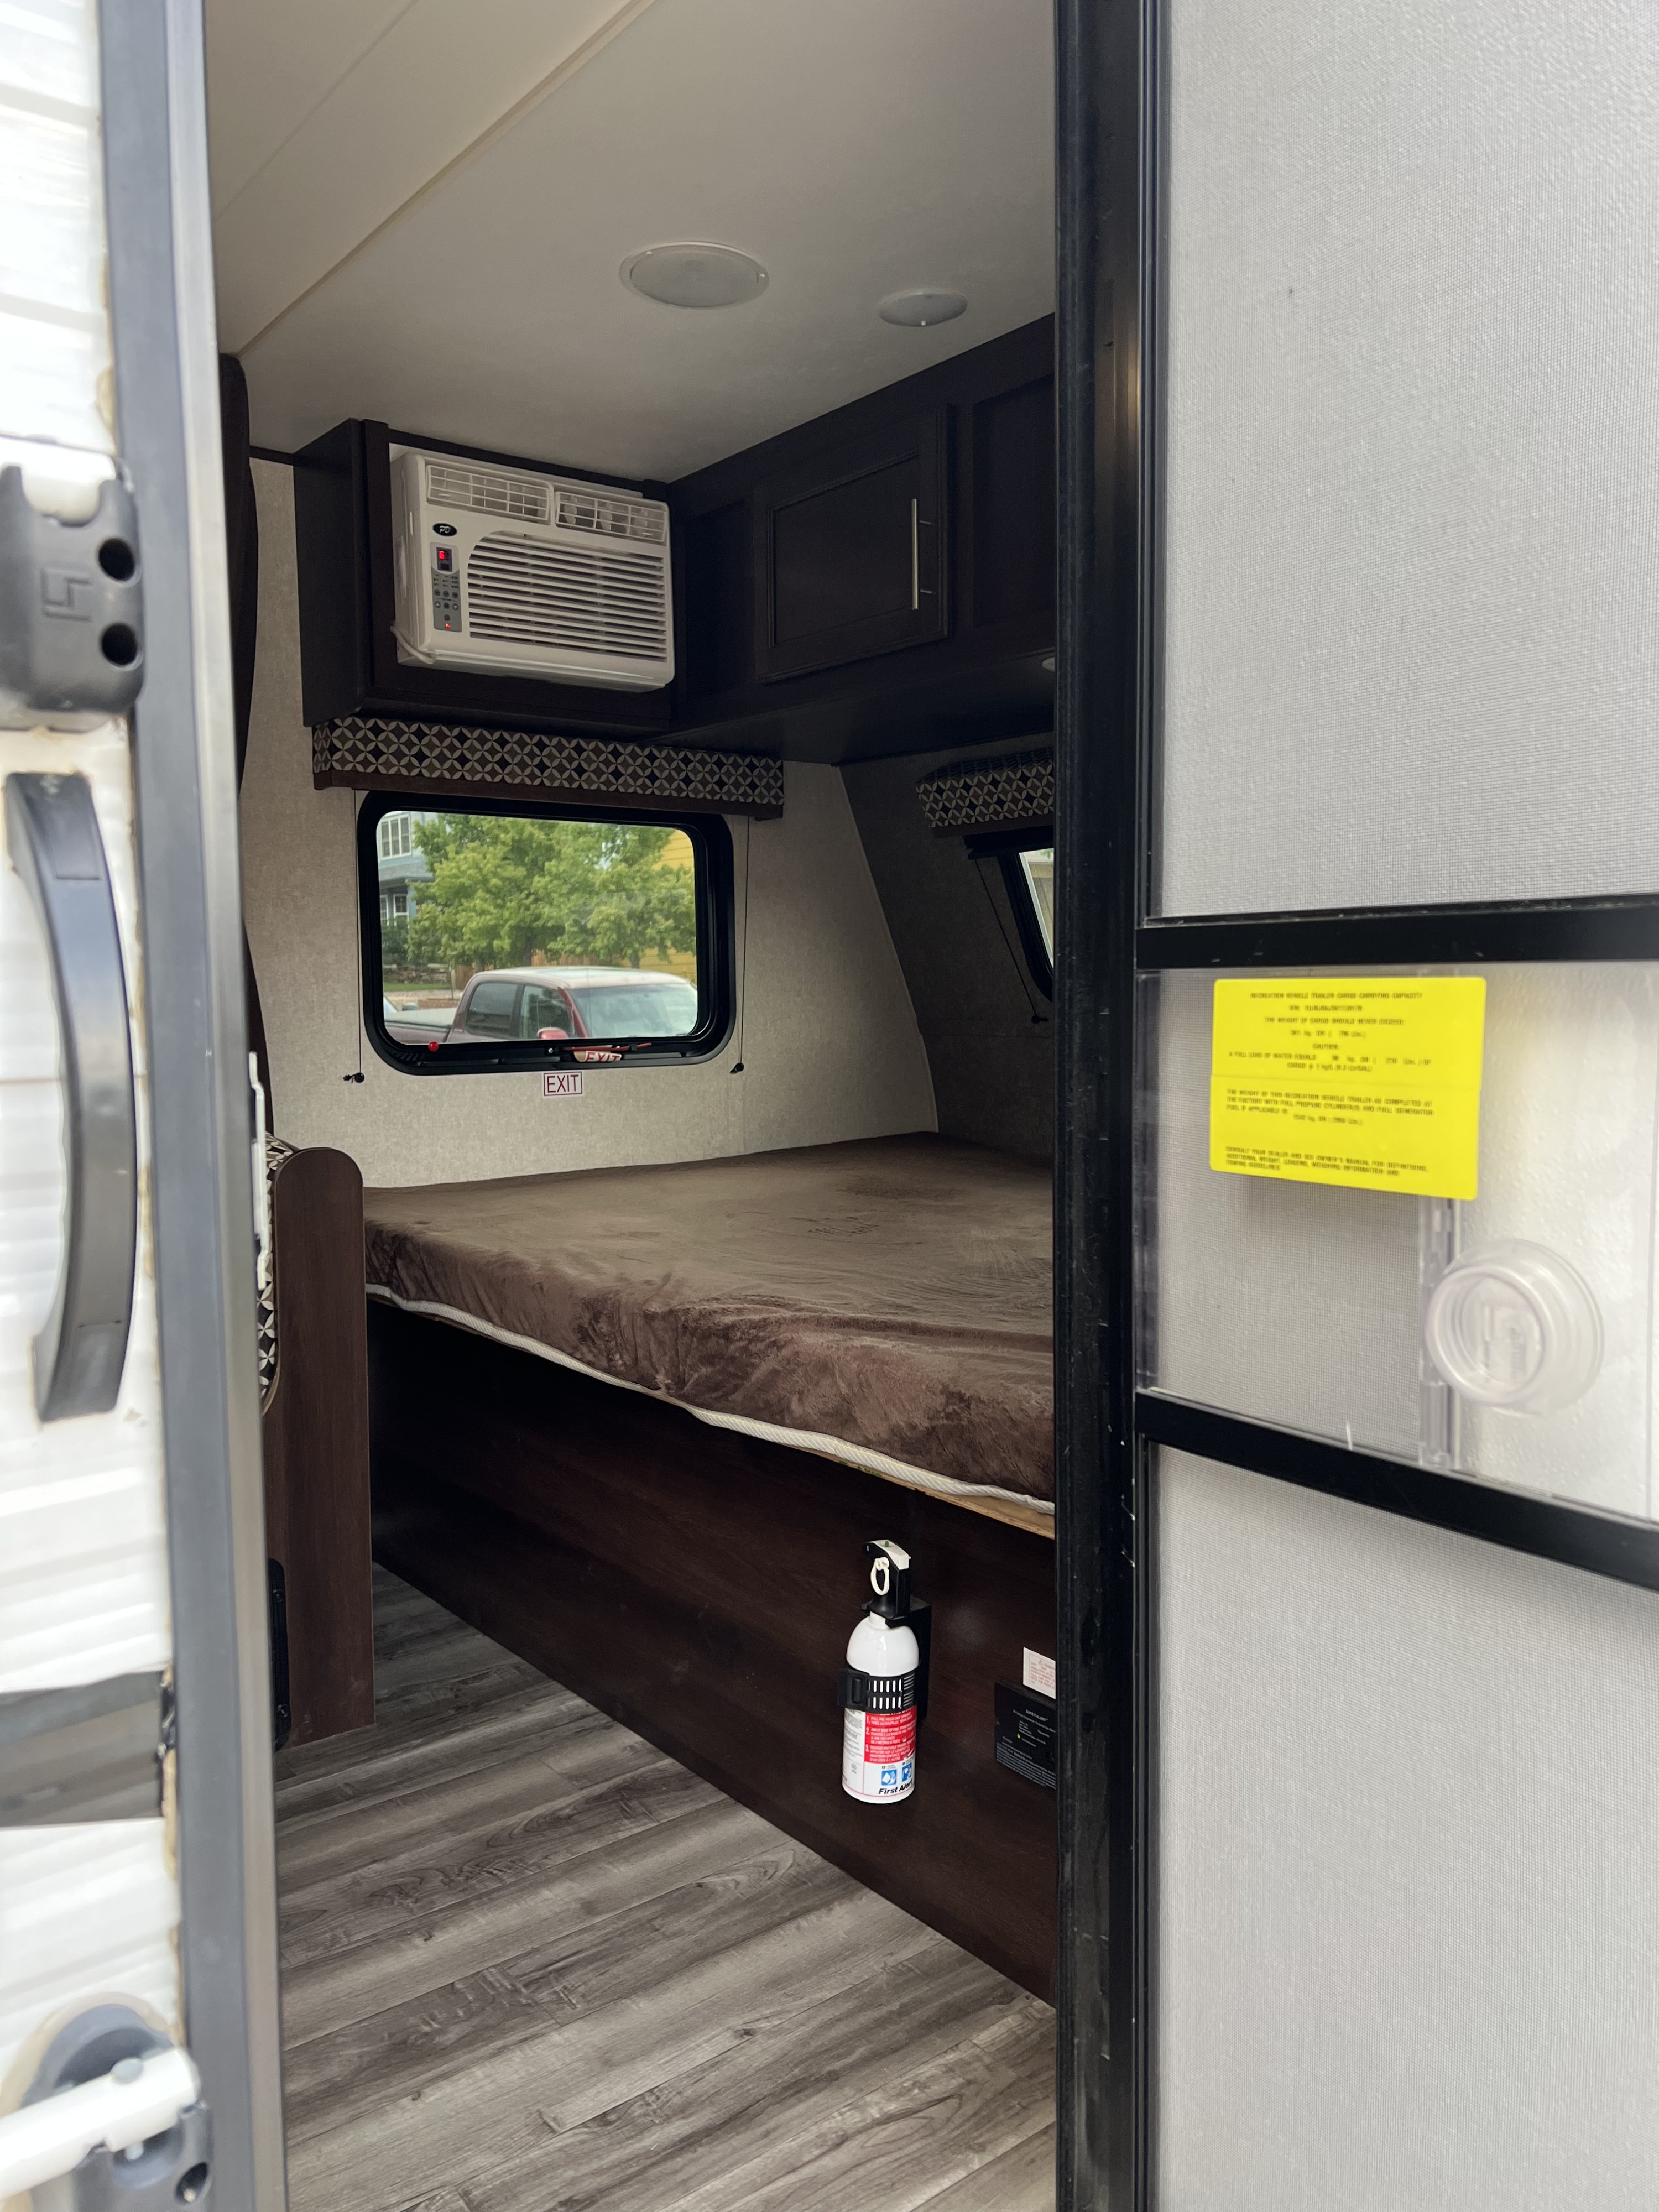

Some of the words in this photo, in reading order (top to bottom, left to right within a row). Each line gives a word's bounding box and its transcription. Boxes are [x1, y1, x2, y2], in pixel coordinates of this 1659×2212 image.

[585, 1052, 620, 1062] EXIT
[547, 1074, 579, 1093] EXIT
[899, 1777, 913, 1792] Alert
